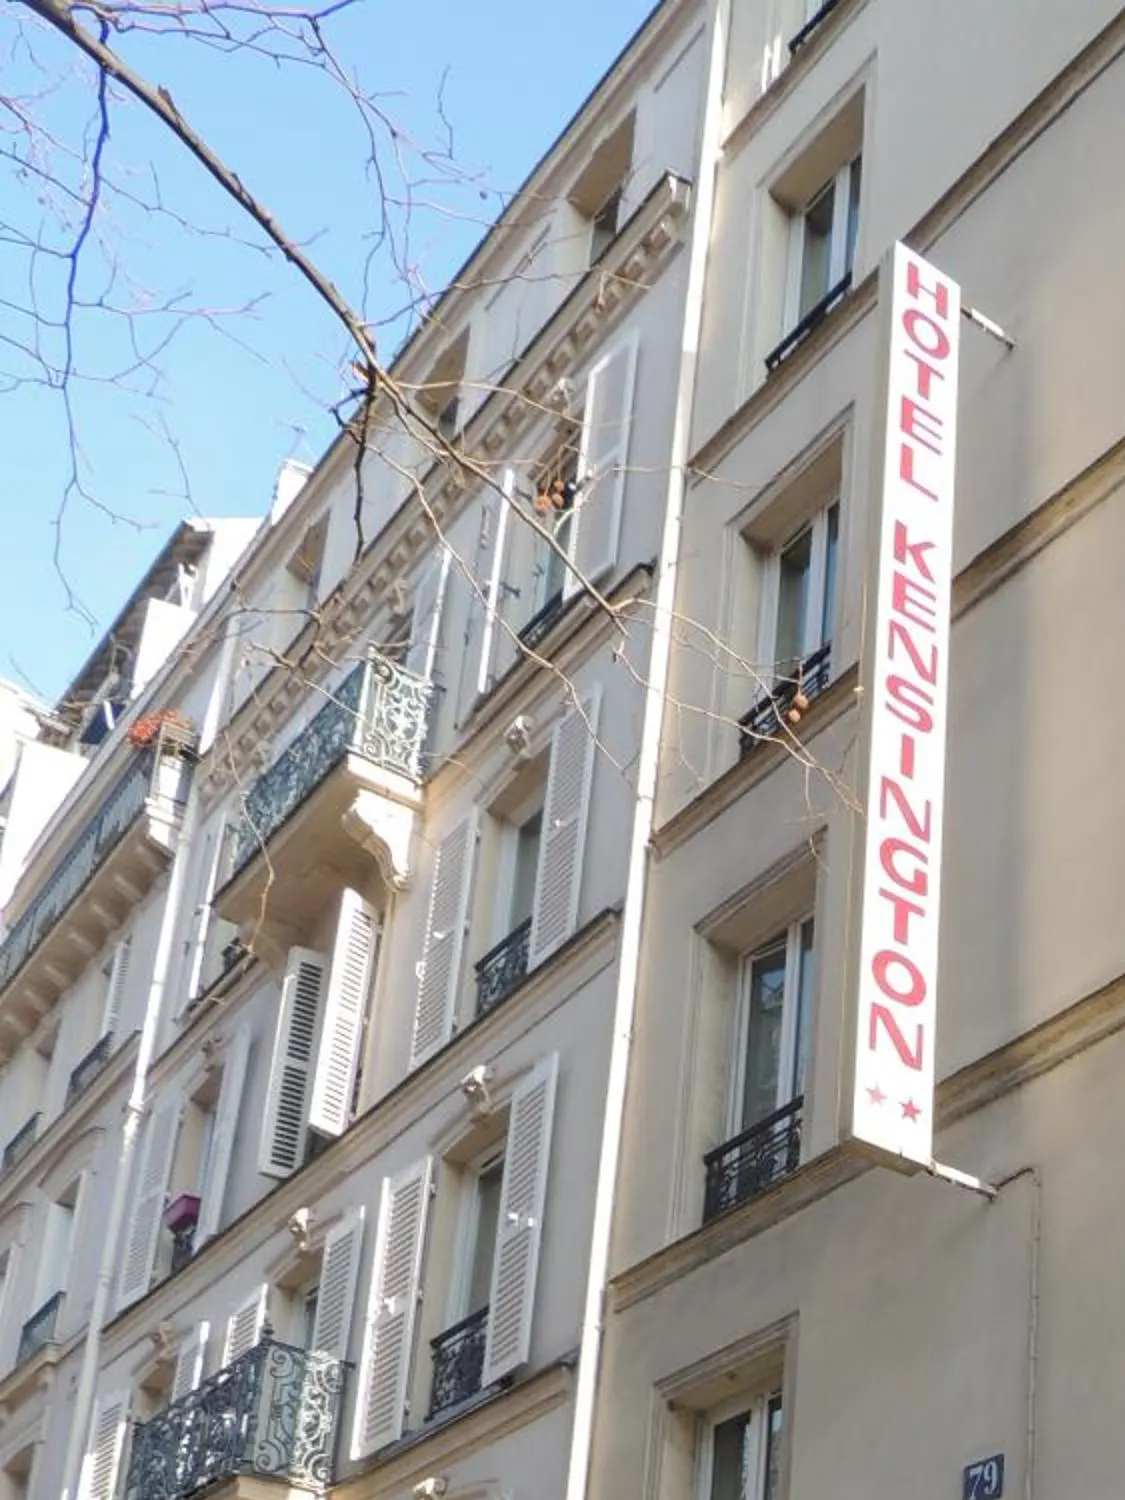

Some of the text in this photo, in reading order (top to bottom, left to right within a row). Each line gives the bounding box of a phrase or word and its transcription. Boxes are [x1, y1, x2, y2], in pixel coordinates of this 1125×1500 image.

[869, 262, 951, 1071] HOTEL KENSINGTON
[968, 1460, 998, 1500] 79
